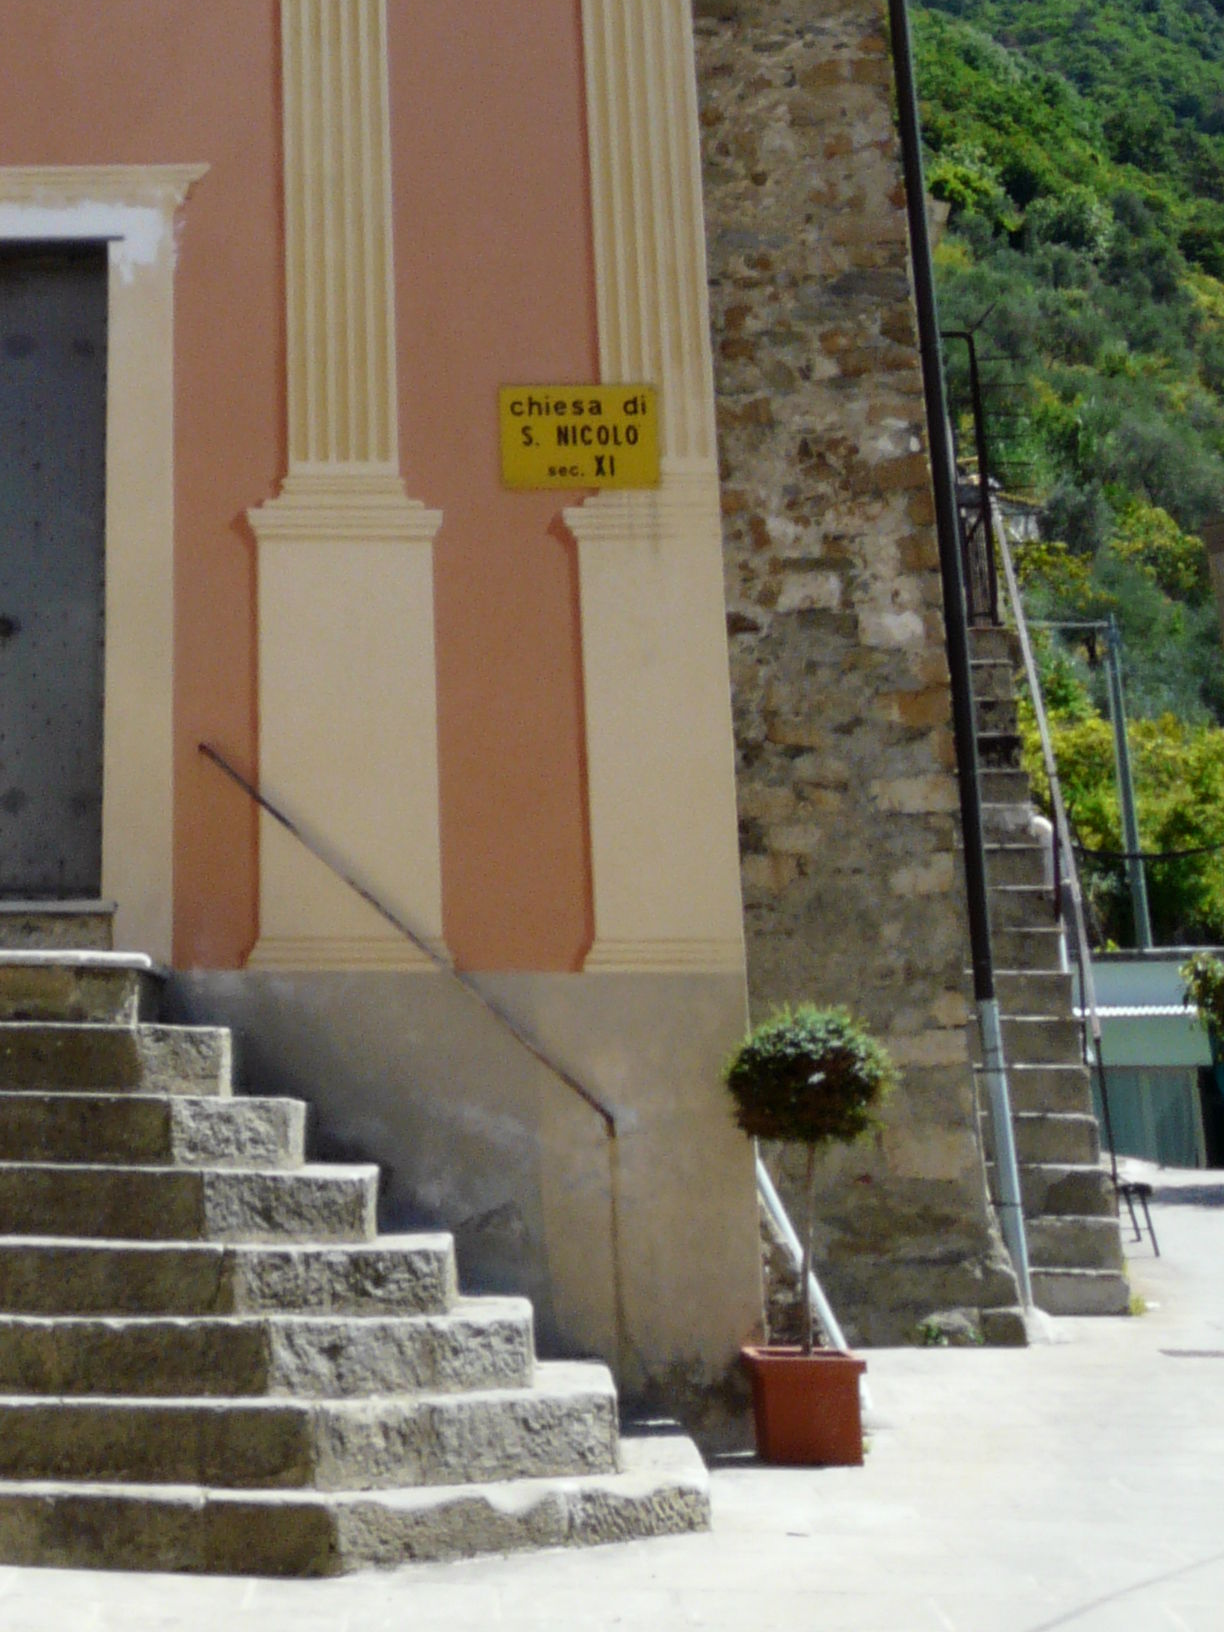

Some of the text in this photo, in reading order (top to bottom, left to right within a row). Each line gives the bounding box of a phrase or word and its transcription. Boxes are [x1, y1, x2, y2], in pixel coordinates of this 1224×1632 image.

[623, 396, 647, 416] di
[521, 425, 540, 447] S.
[548, 455, 615, 477] sec. XI
